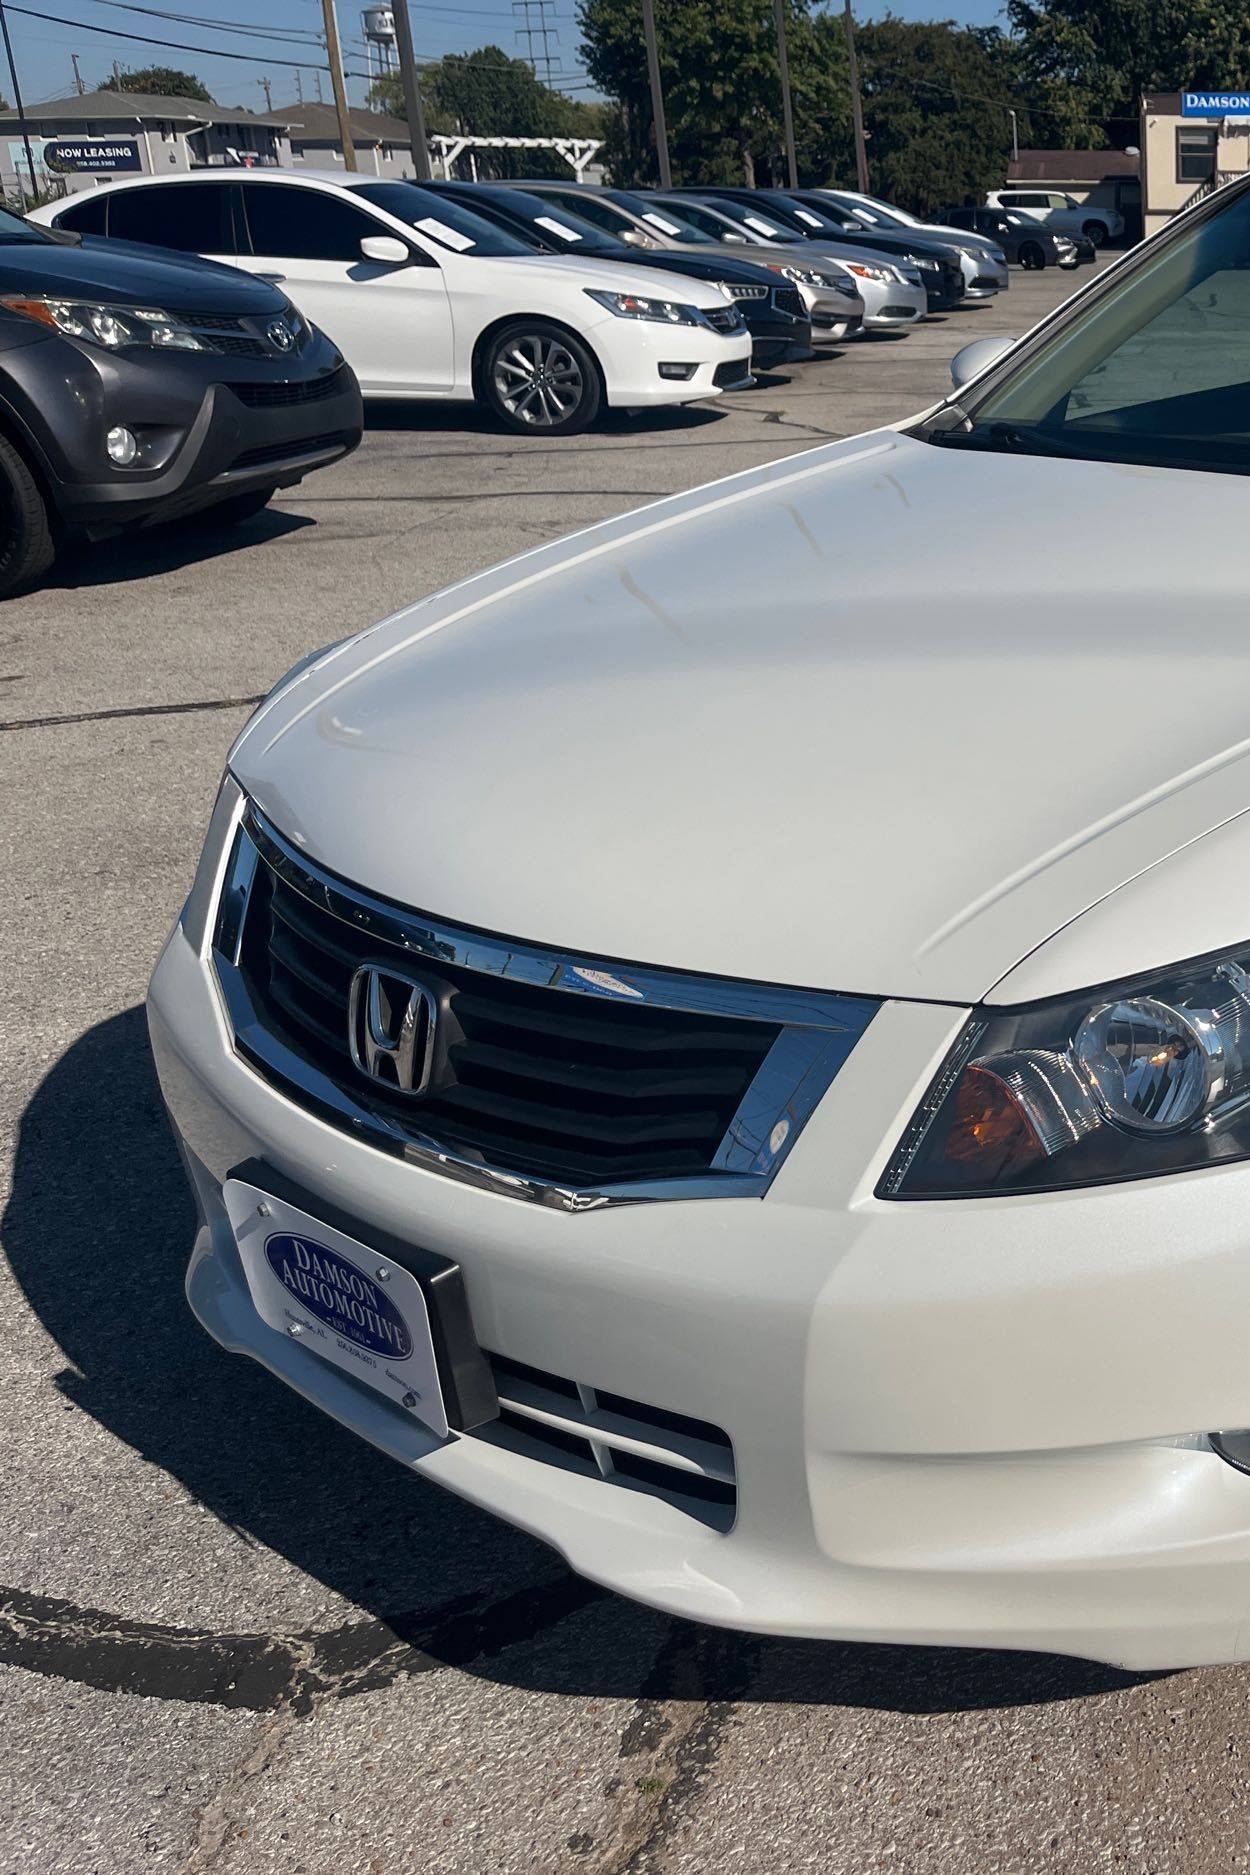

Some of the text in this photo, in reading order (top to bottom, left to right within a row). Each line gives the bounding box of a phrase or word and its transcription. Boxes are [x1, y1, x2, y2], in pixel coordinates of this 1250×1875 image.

[1186, 94, 1249, 108] DAMSON
[57, 147, 132, 158] NOW LEASING
[292, 1239, 378, 1308] DAMSON
[282, 1259, 407, 1353] AUTOMOTIVE
